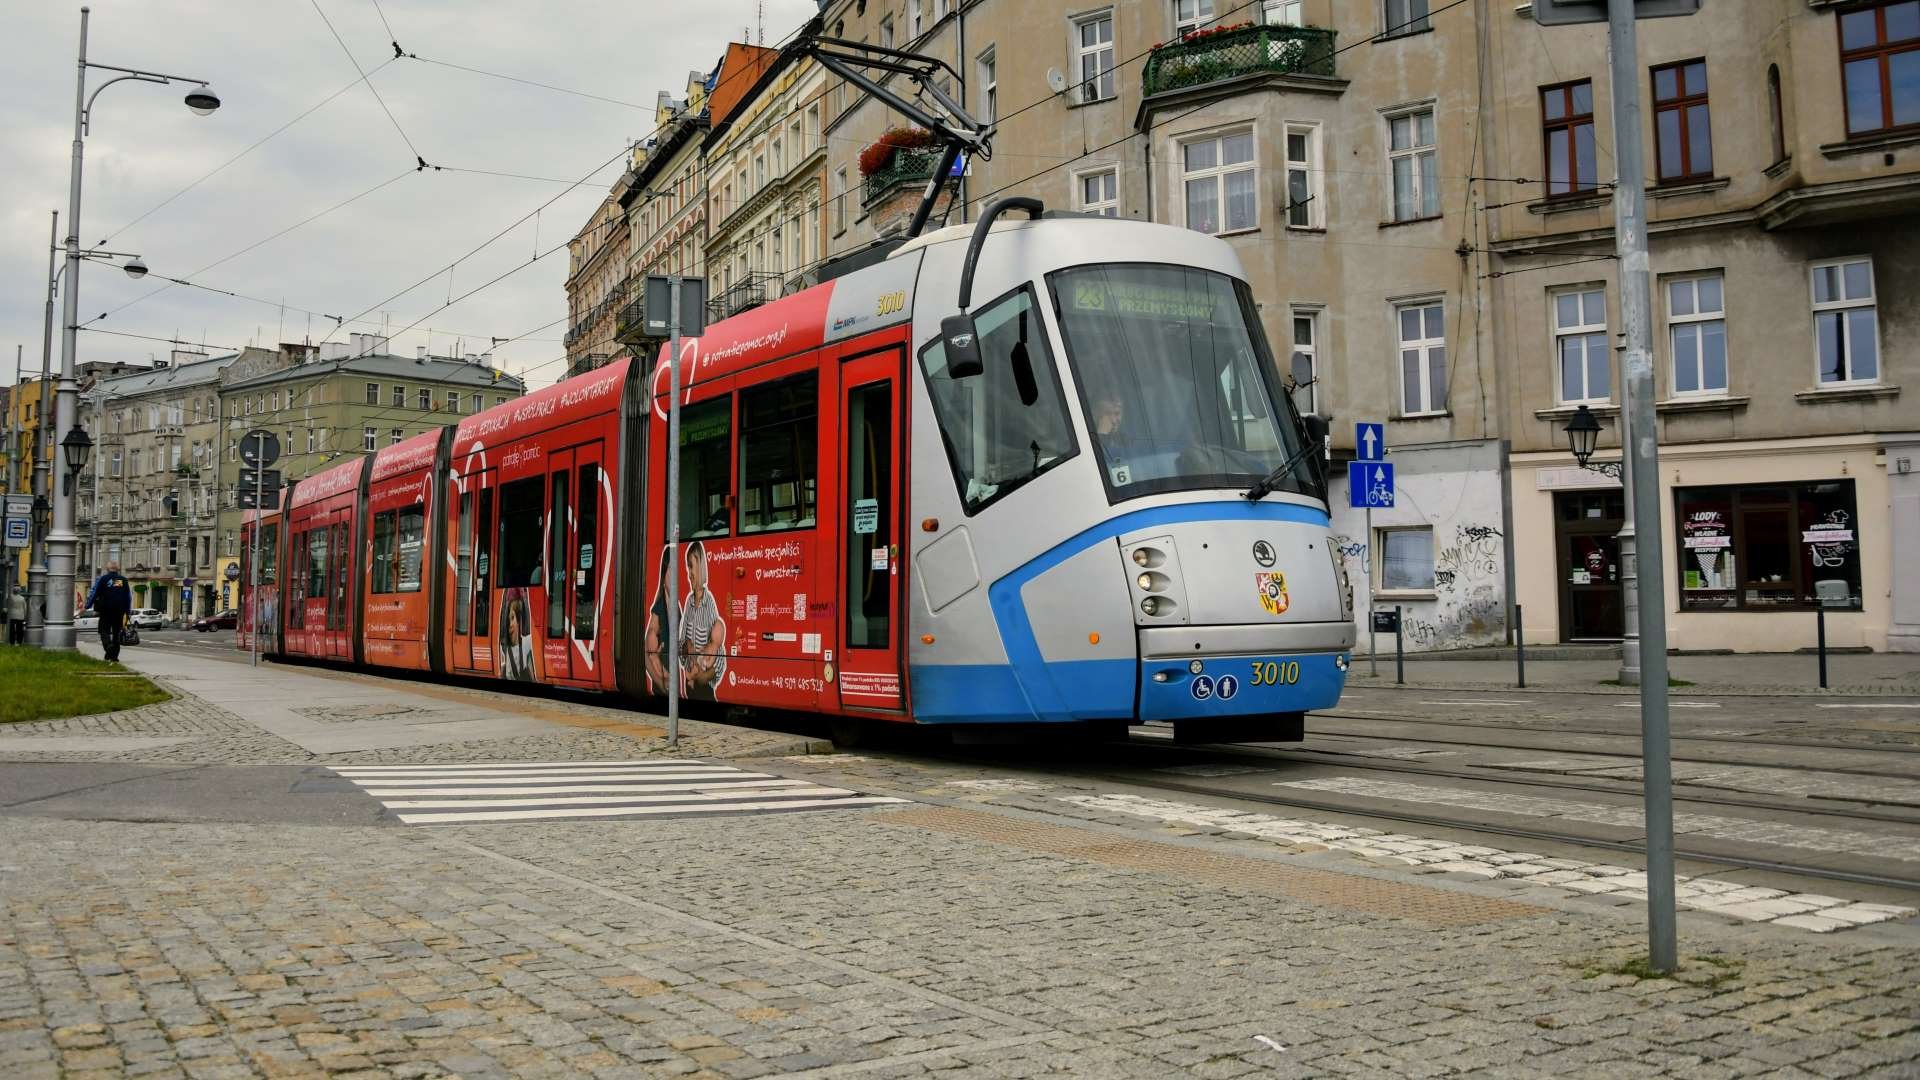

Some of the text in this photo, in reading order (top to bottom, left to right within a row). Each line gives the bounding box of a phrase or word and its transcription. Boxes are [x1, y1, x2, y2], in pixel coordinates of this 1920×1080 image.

[876, 291, 905, 317] 3010
[1117, 471, 1127, 483] 6
[1695, 511, 1718, 521] LODY
[1261, 594, 1275, 611] W
[1250, 661, 1300, 686] 3010
[771, 676, 783, 689] +48
[784, 677, 796, 690] 509
[798, 677, 810, 691] 685
